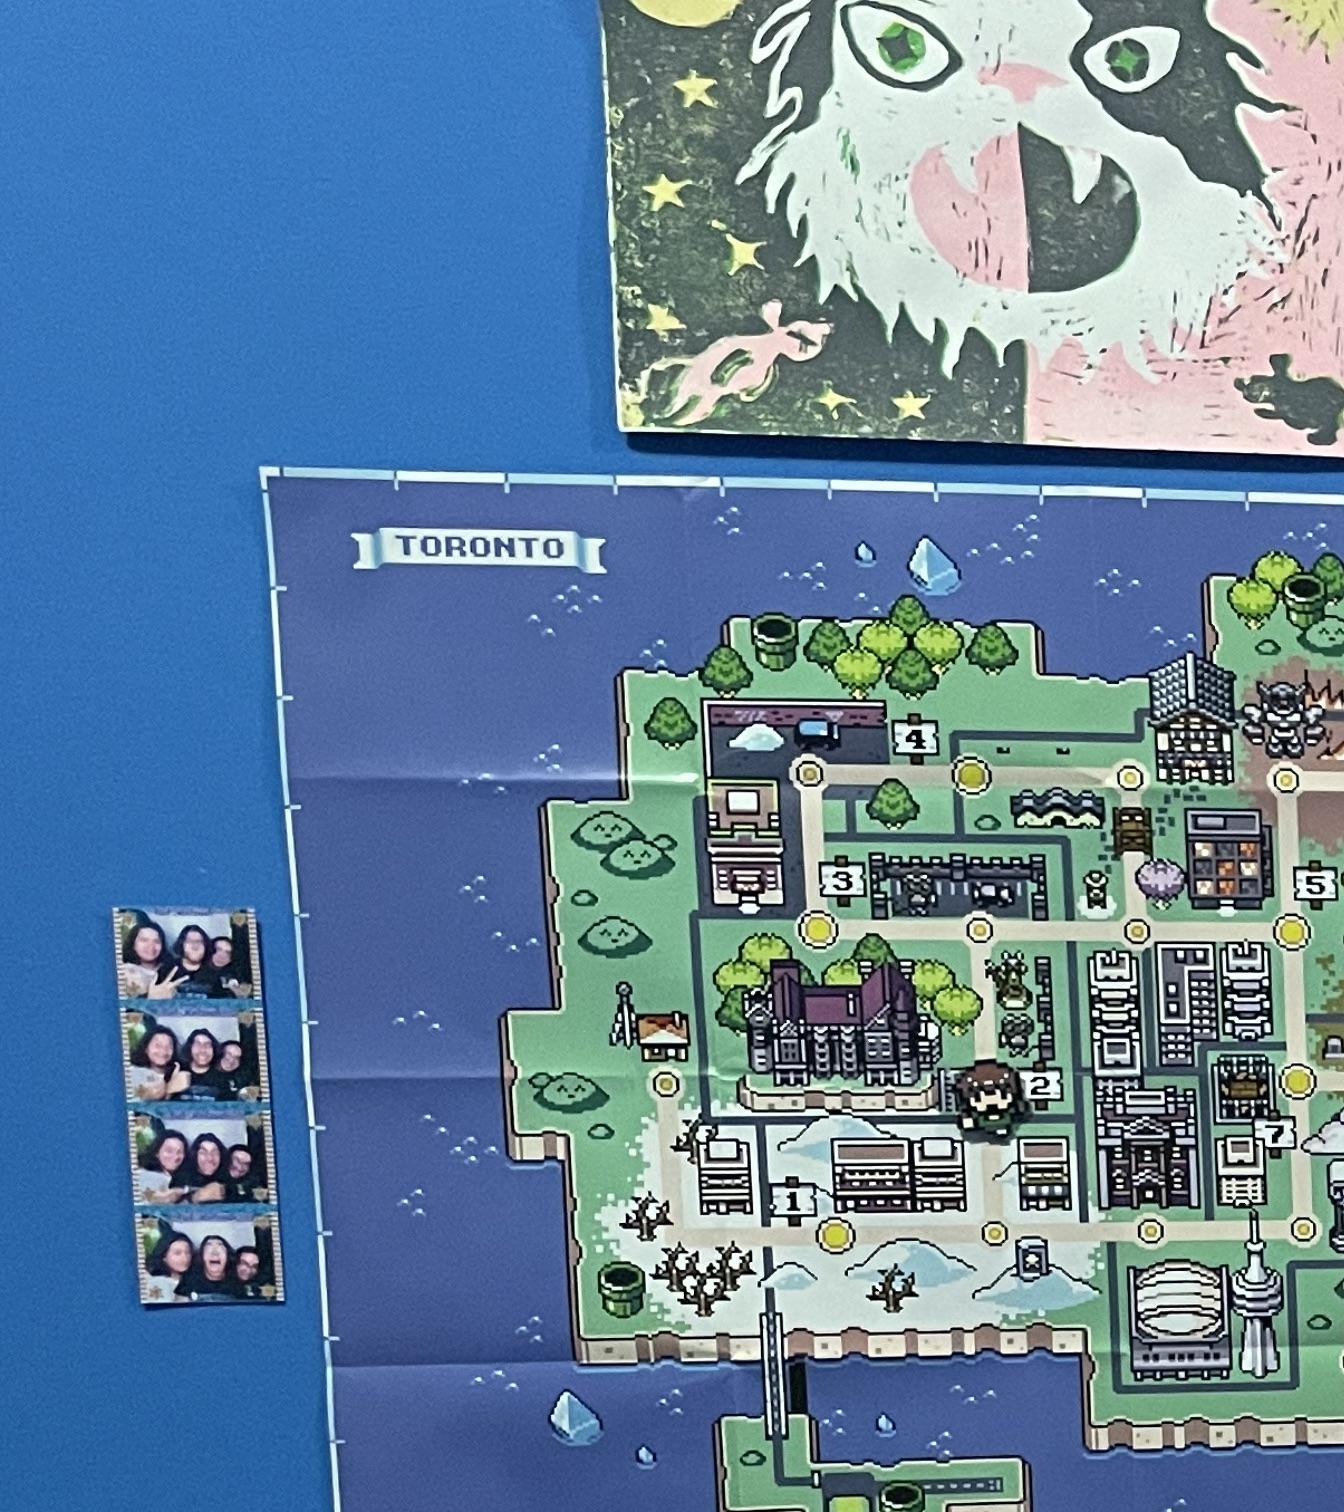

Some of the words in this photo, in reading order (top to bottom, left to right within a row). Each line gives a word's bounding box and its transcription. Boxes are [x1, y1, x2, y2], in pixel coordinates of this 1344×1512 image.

[395, 534, 565, 560] TORONTO
[903, 729, 926, 750] 4
[833, 870, 854, 890] 3
[1305, 875, 1326, 896] 5
[1029, 1077, 1051, 1095] 2
[1265, 1124, 1284, 1145] 7
[786, 1192, 802, 1211] 1
